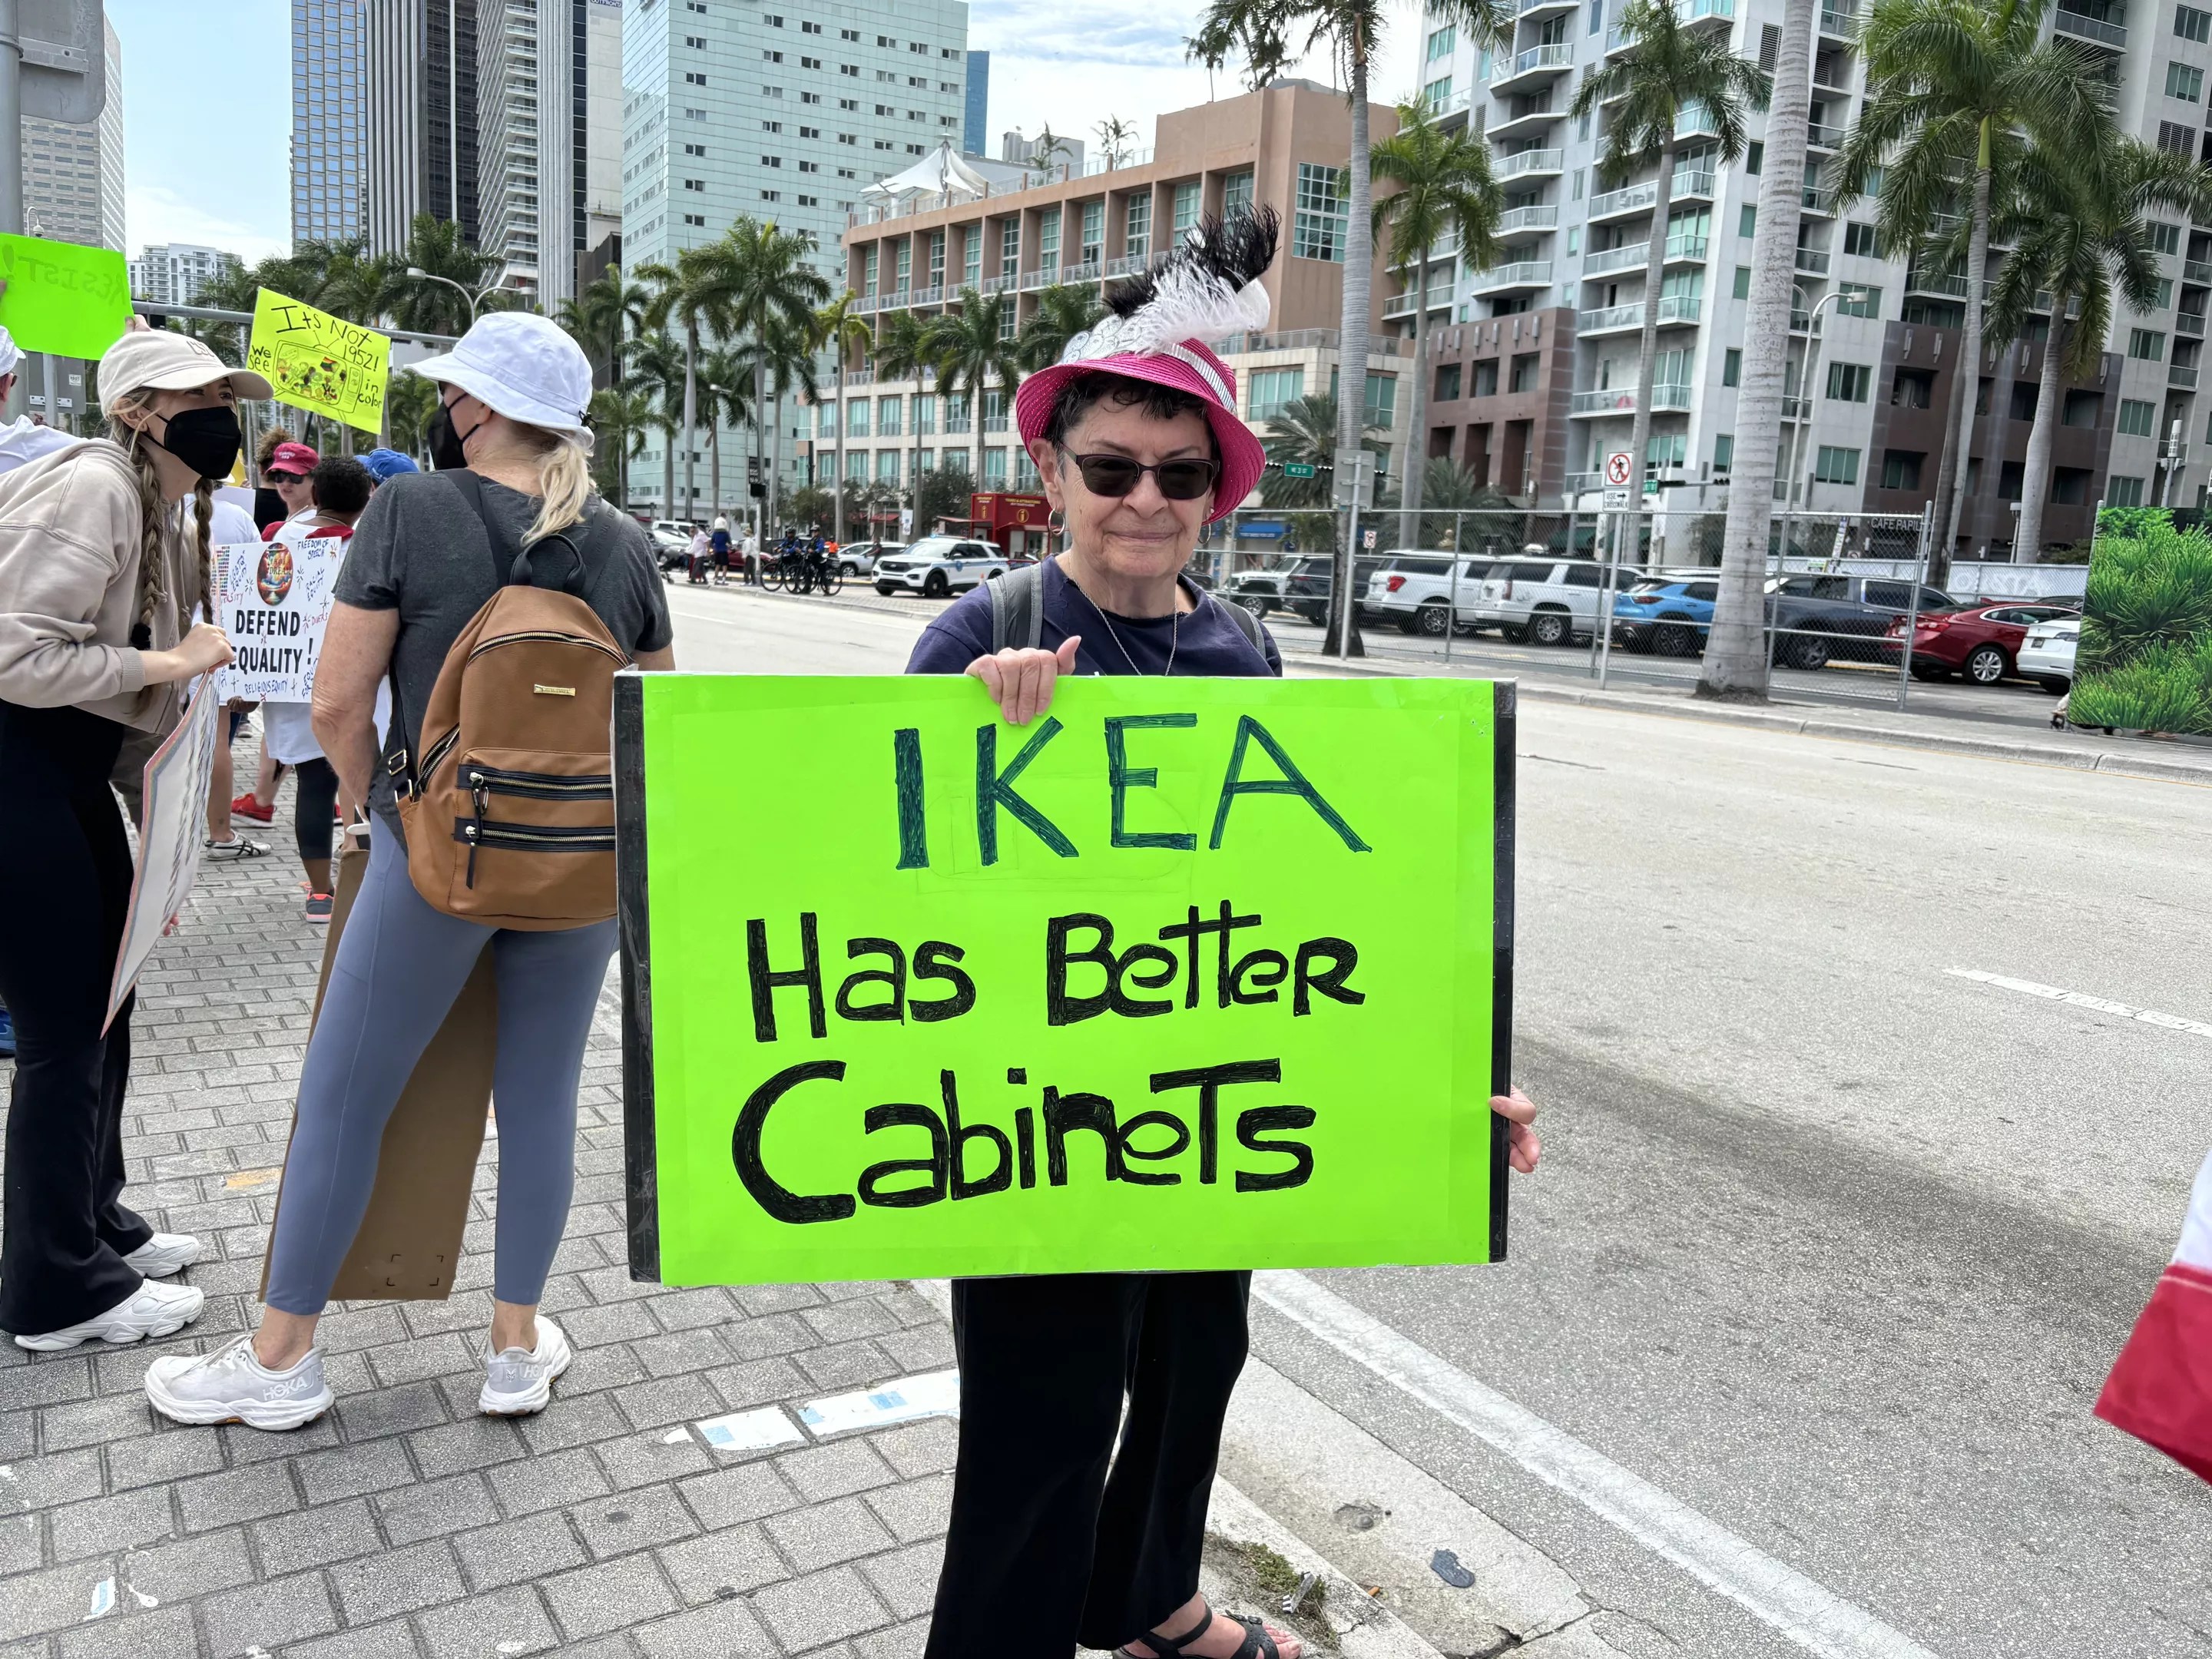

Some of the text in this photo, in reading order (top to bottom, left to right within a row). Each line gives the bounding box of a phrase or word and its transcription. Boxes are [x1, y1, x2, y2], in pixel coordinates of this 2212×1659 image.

[343, 344, 379, 372] 1952!
[365, 379, 379, 393] in
[1871, 517, 1895, 530] CAFE
[235, 610, 300, 636] DEFEND
[894, 712, 1373, 869] IKEA
[747, 912, 976, 1043] Has
[262, 1376, 308, 1402] HOKA
